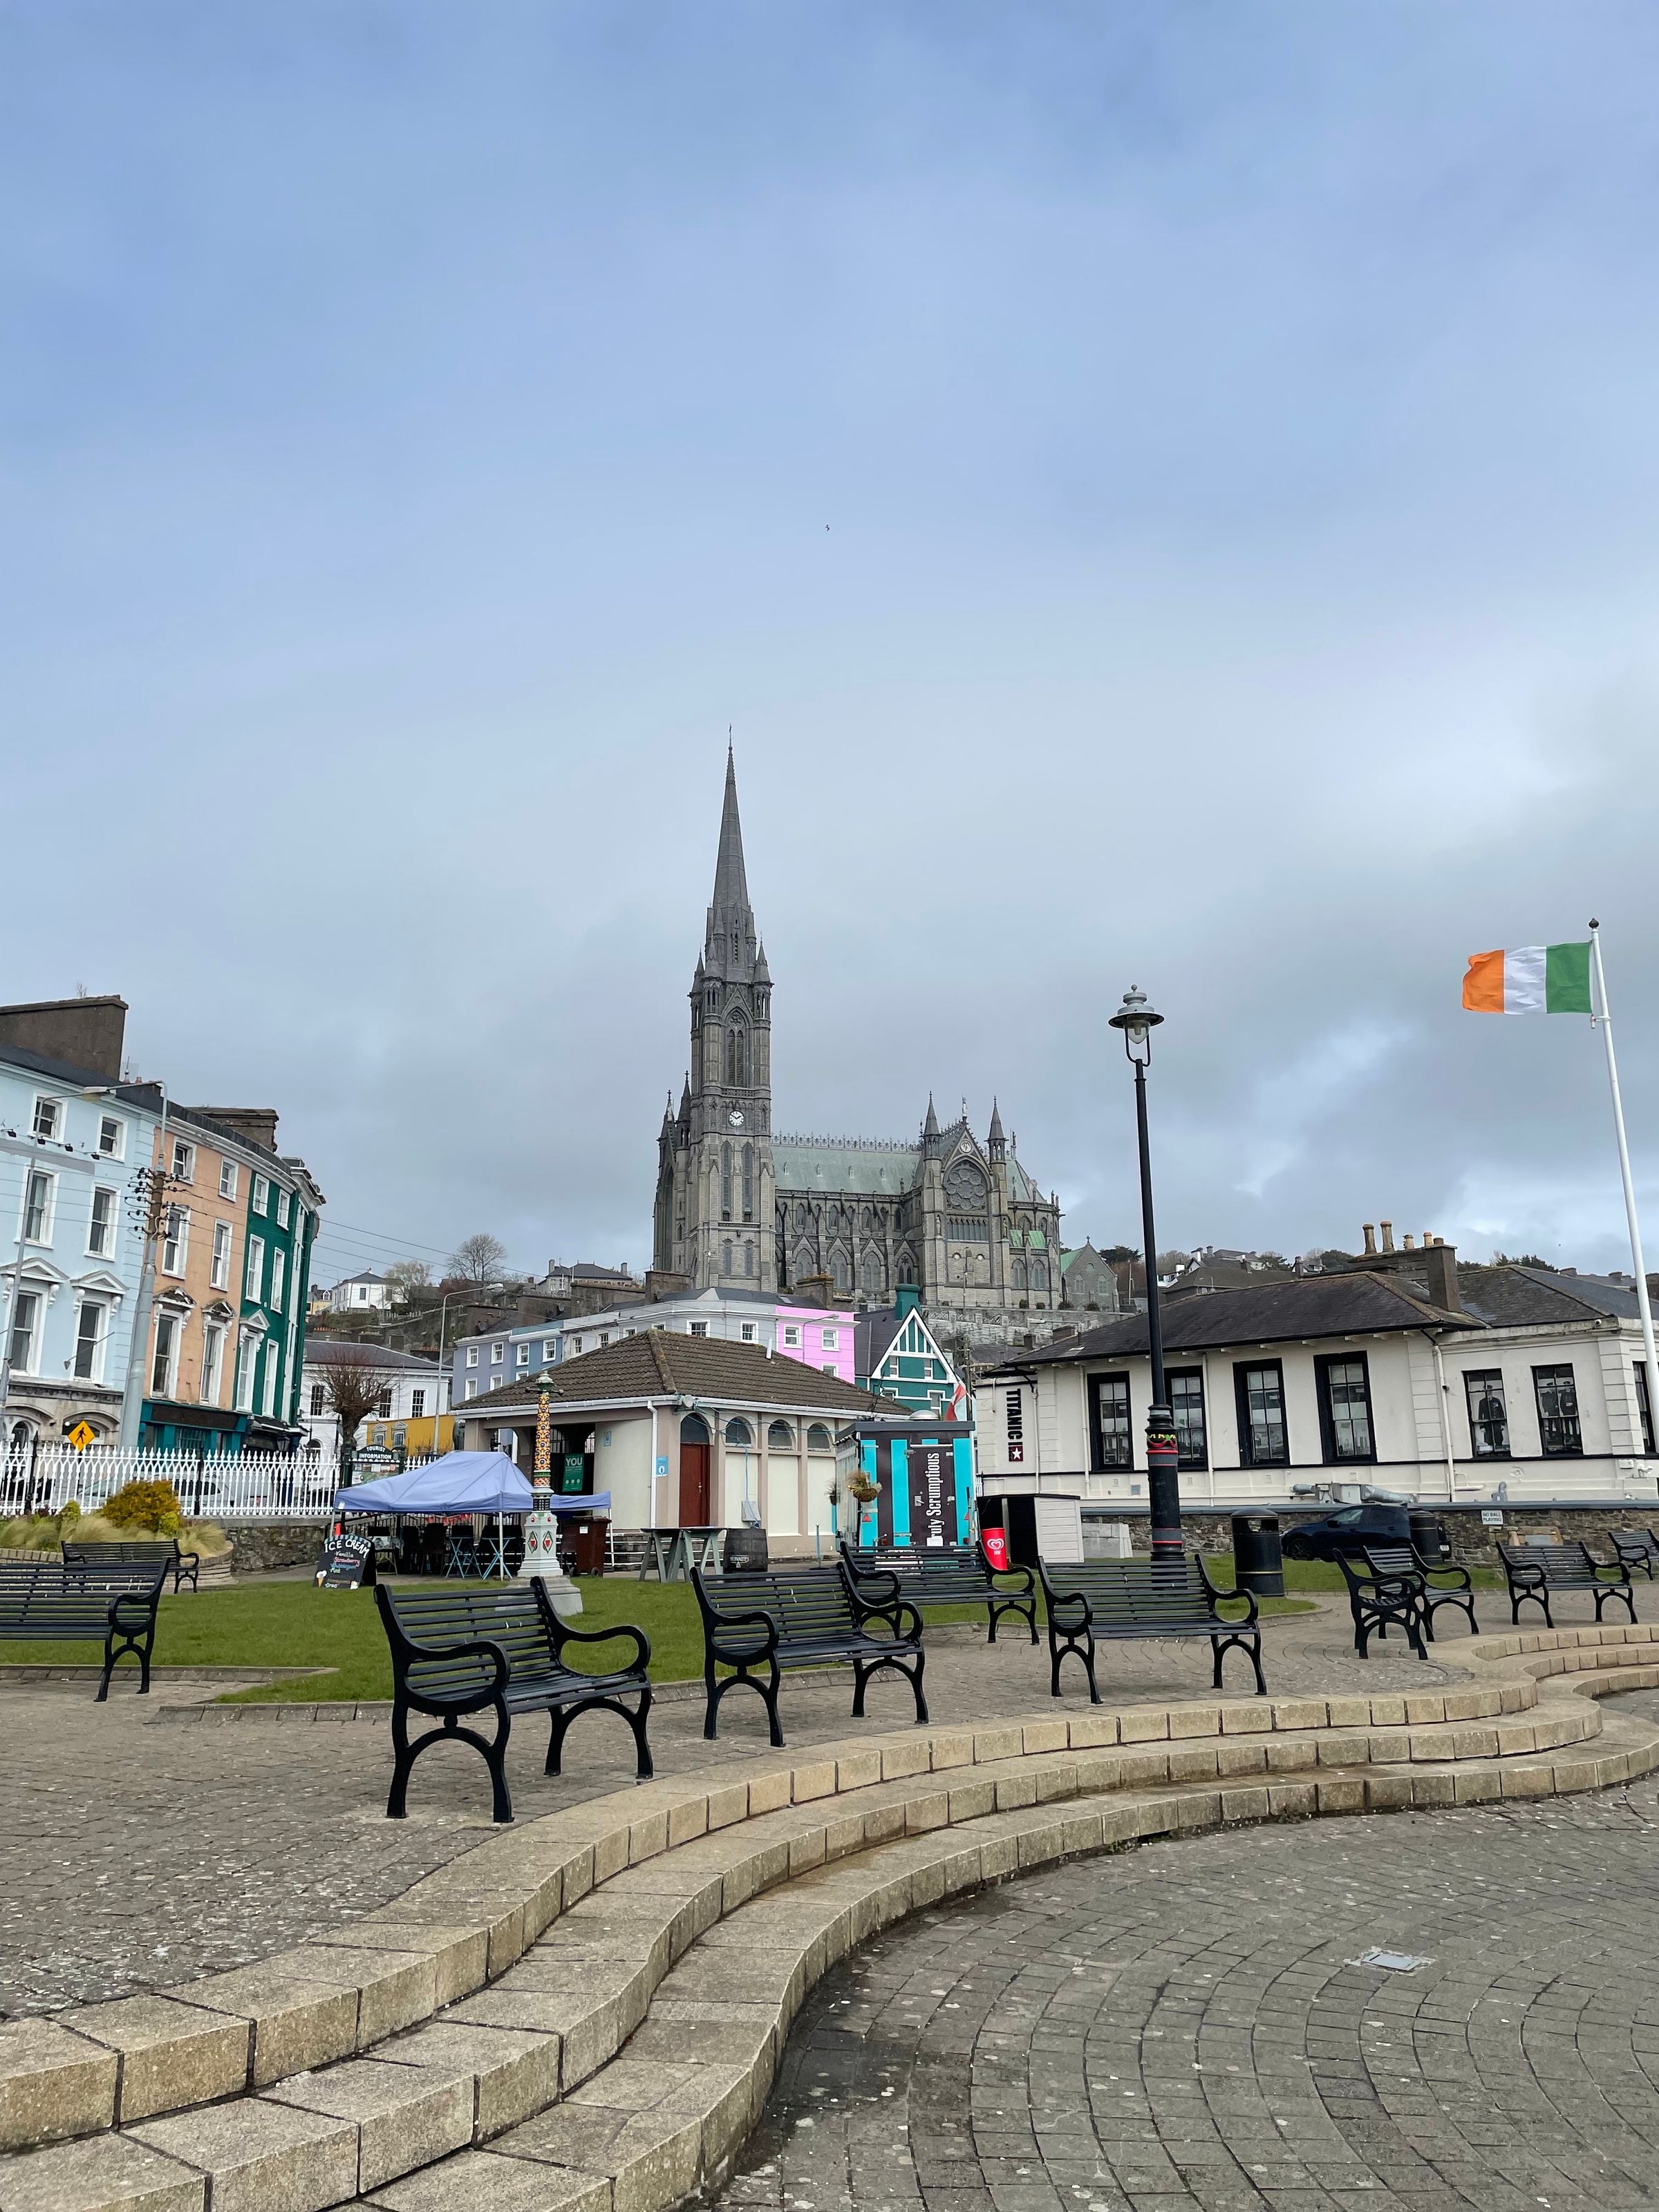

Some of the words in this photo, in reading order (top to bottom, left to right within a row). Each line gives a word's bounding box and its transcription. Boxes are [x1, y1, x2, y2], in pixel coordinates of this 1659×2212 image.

[1006, 1388, 1022, 1439] TITANIC
[566, 1457, 583, 1465] YOU
[925, 1452, 944, 1516] Scrumptious
[928, 1519, 944, 1539] ruly
[324, 1540, 342, 1553] ICE
[346, 1539, 370, 1559] CREAM
